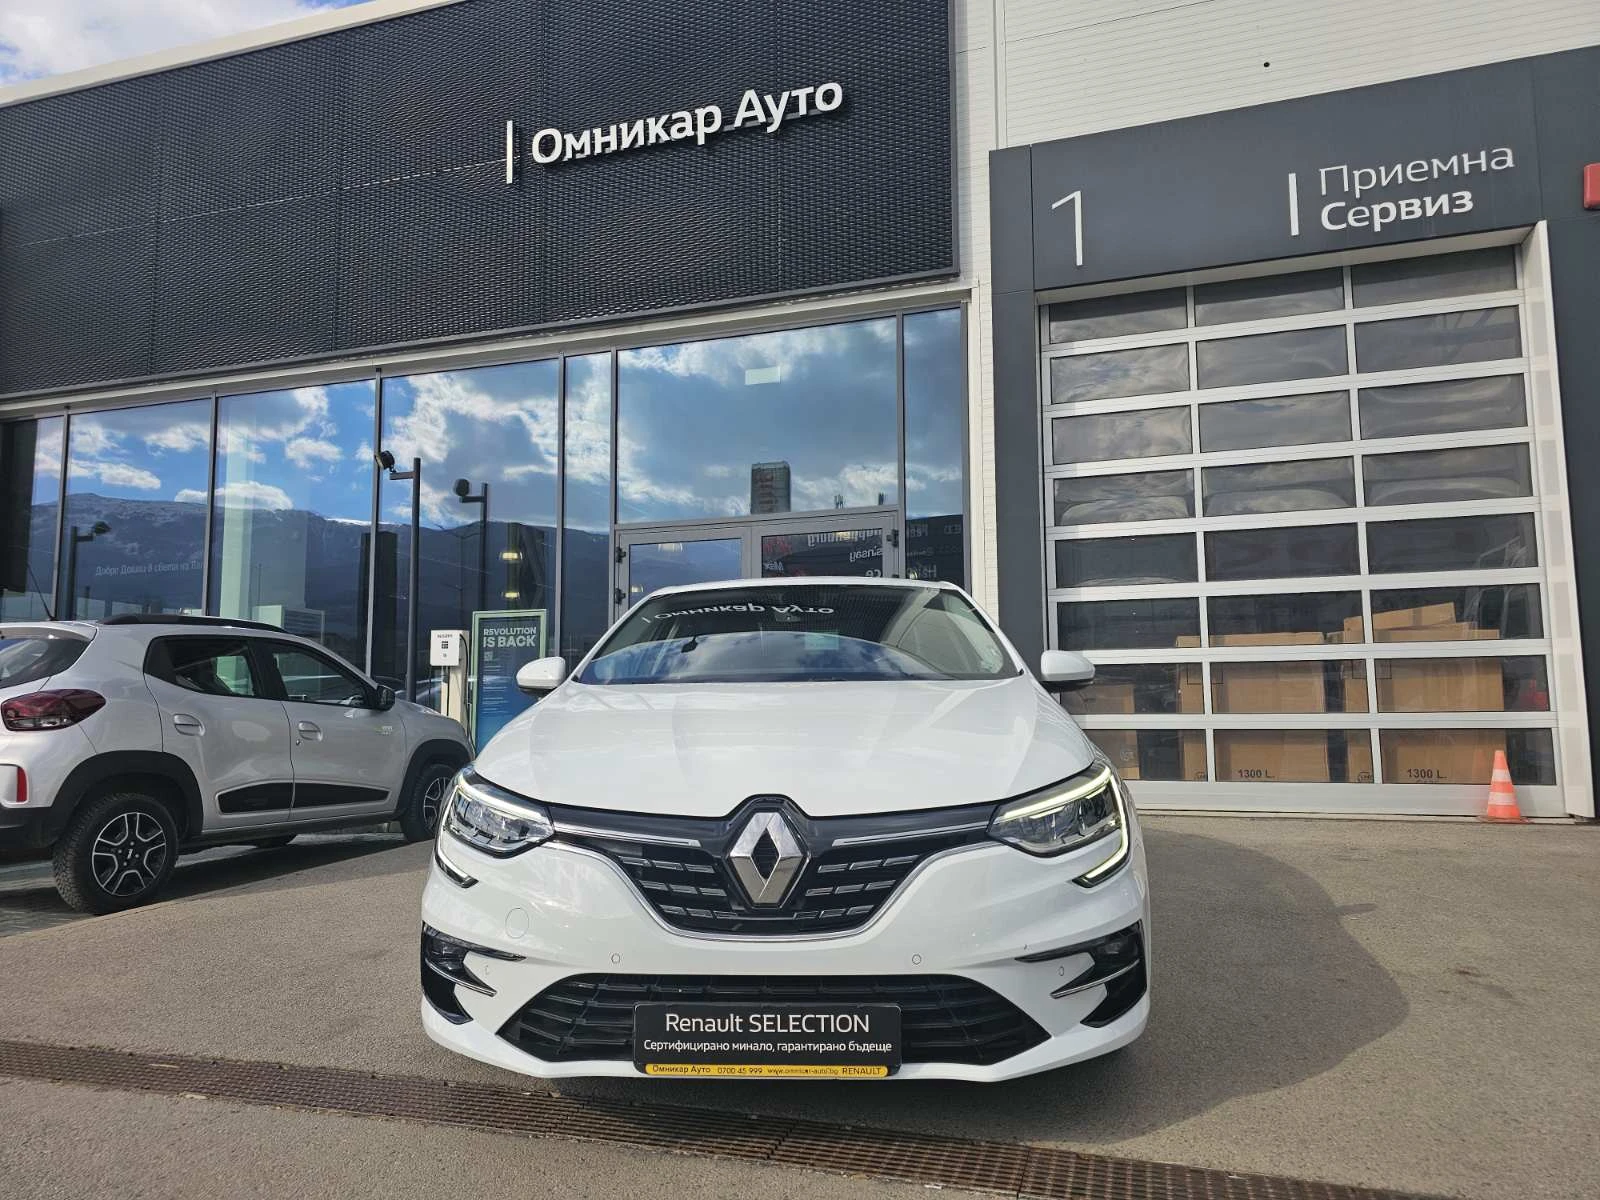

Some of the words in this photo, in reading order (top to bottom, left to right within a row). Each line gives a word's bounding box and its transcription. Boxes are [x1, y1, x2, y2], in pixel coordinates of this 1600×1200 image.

[531, 103, 723, 165] Омникар
[733, 81, 844, 134] Ауто
[1318, 146, 1515, 198] Приемна
[1319, 187, 1475, 232] Сервиз
[1050, 189, 1084, 267] 1
[482, 636, 496, 648] IS
[497, 634, 537, 648] BACK
[1237, 768, 1262, 779] 1300
[1406, 768, 1433, 779] 1300
[665, 1013, 743, 1033] Renault
[749, 1014, 870, 1033] SELECTION
[643, 1039, 731, 1053] Сертифицирано
[731, 1041, 776, 1053] минало,
[776, 1041, 846, 1053] гарантирано
[848, 1040, 892, 1053] бъдеще
[652, 1064, 689, 1074] Омникар
[690, 1064, 711, 1074] Ауто
[717, 1067, 736, 1075] 0700
[737, 1067, 748, 1075] 45
[749, 1067, 763, 1075] 999
[841, 1066, 882, 1075] RENAULT
